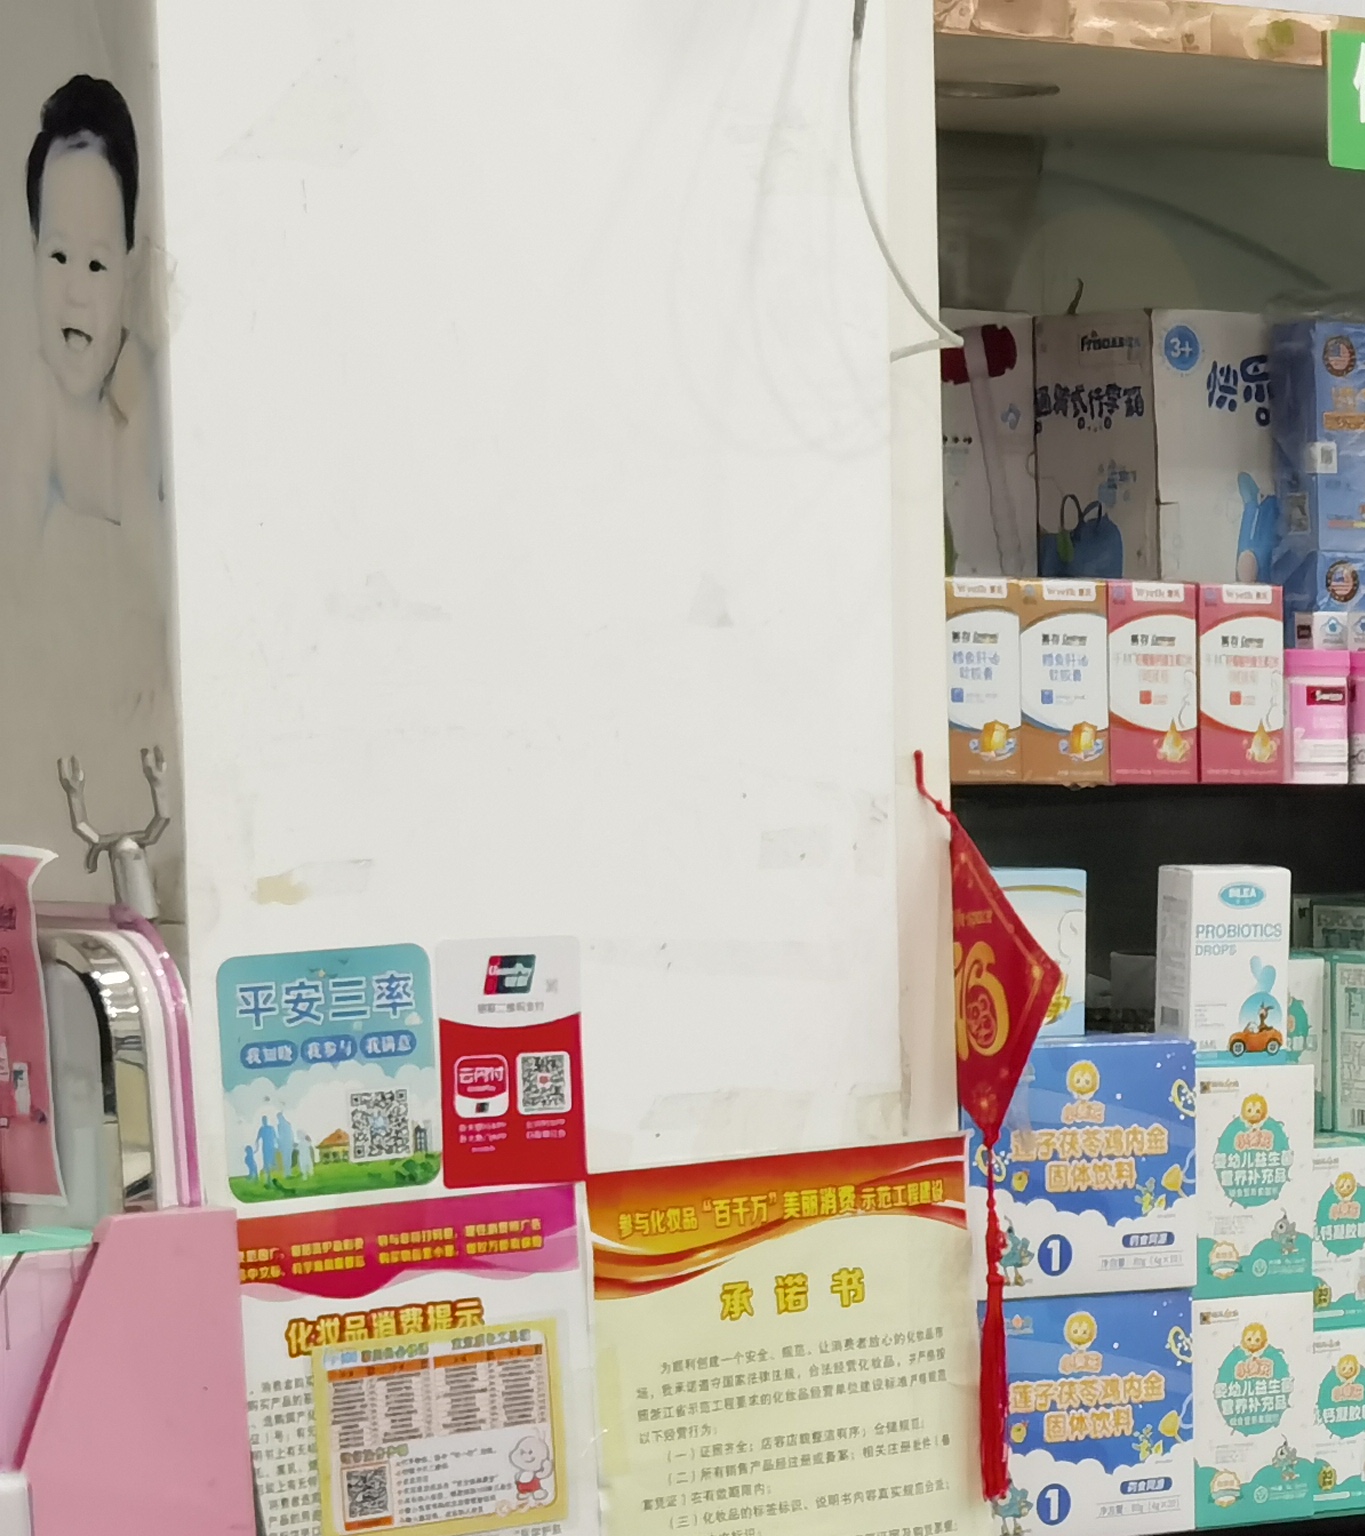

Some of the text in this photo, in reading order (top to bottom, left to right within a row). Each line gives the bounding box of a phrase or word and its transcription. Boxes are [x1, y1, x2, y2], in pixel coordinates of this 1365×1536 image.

[1169, 336, 1194, 361] 3+
[1196, 923, 1282, 940] PROBIOTICS
[1195, 944, 1237, 956] DROPS
[235, 969, 416, 1031] 平安三率
[1046, 1158, 1136, 1193] 固体饮料
[1220, 1168, 1288, 1186] 营养补充品
[1047, 1239, 1060, 1272] 1
[720, 1267, 866, 1321] 承诺书
[285, 1297, 484, 1358] 化妆品消费提示
[1221, 1398, 1287, 1416] 营养补充品
[1044, 1405, 1134, 1443] 固体饮料
[1045, 1488, 1059, 1520] 1
